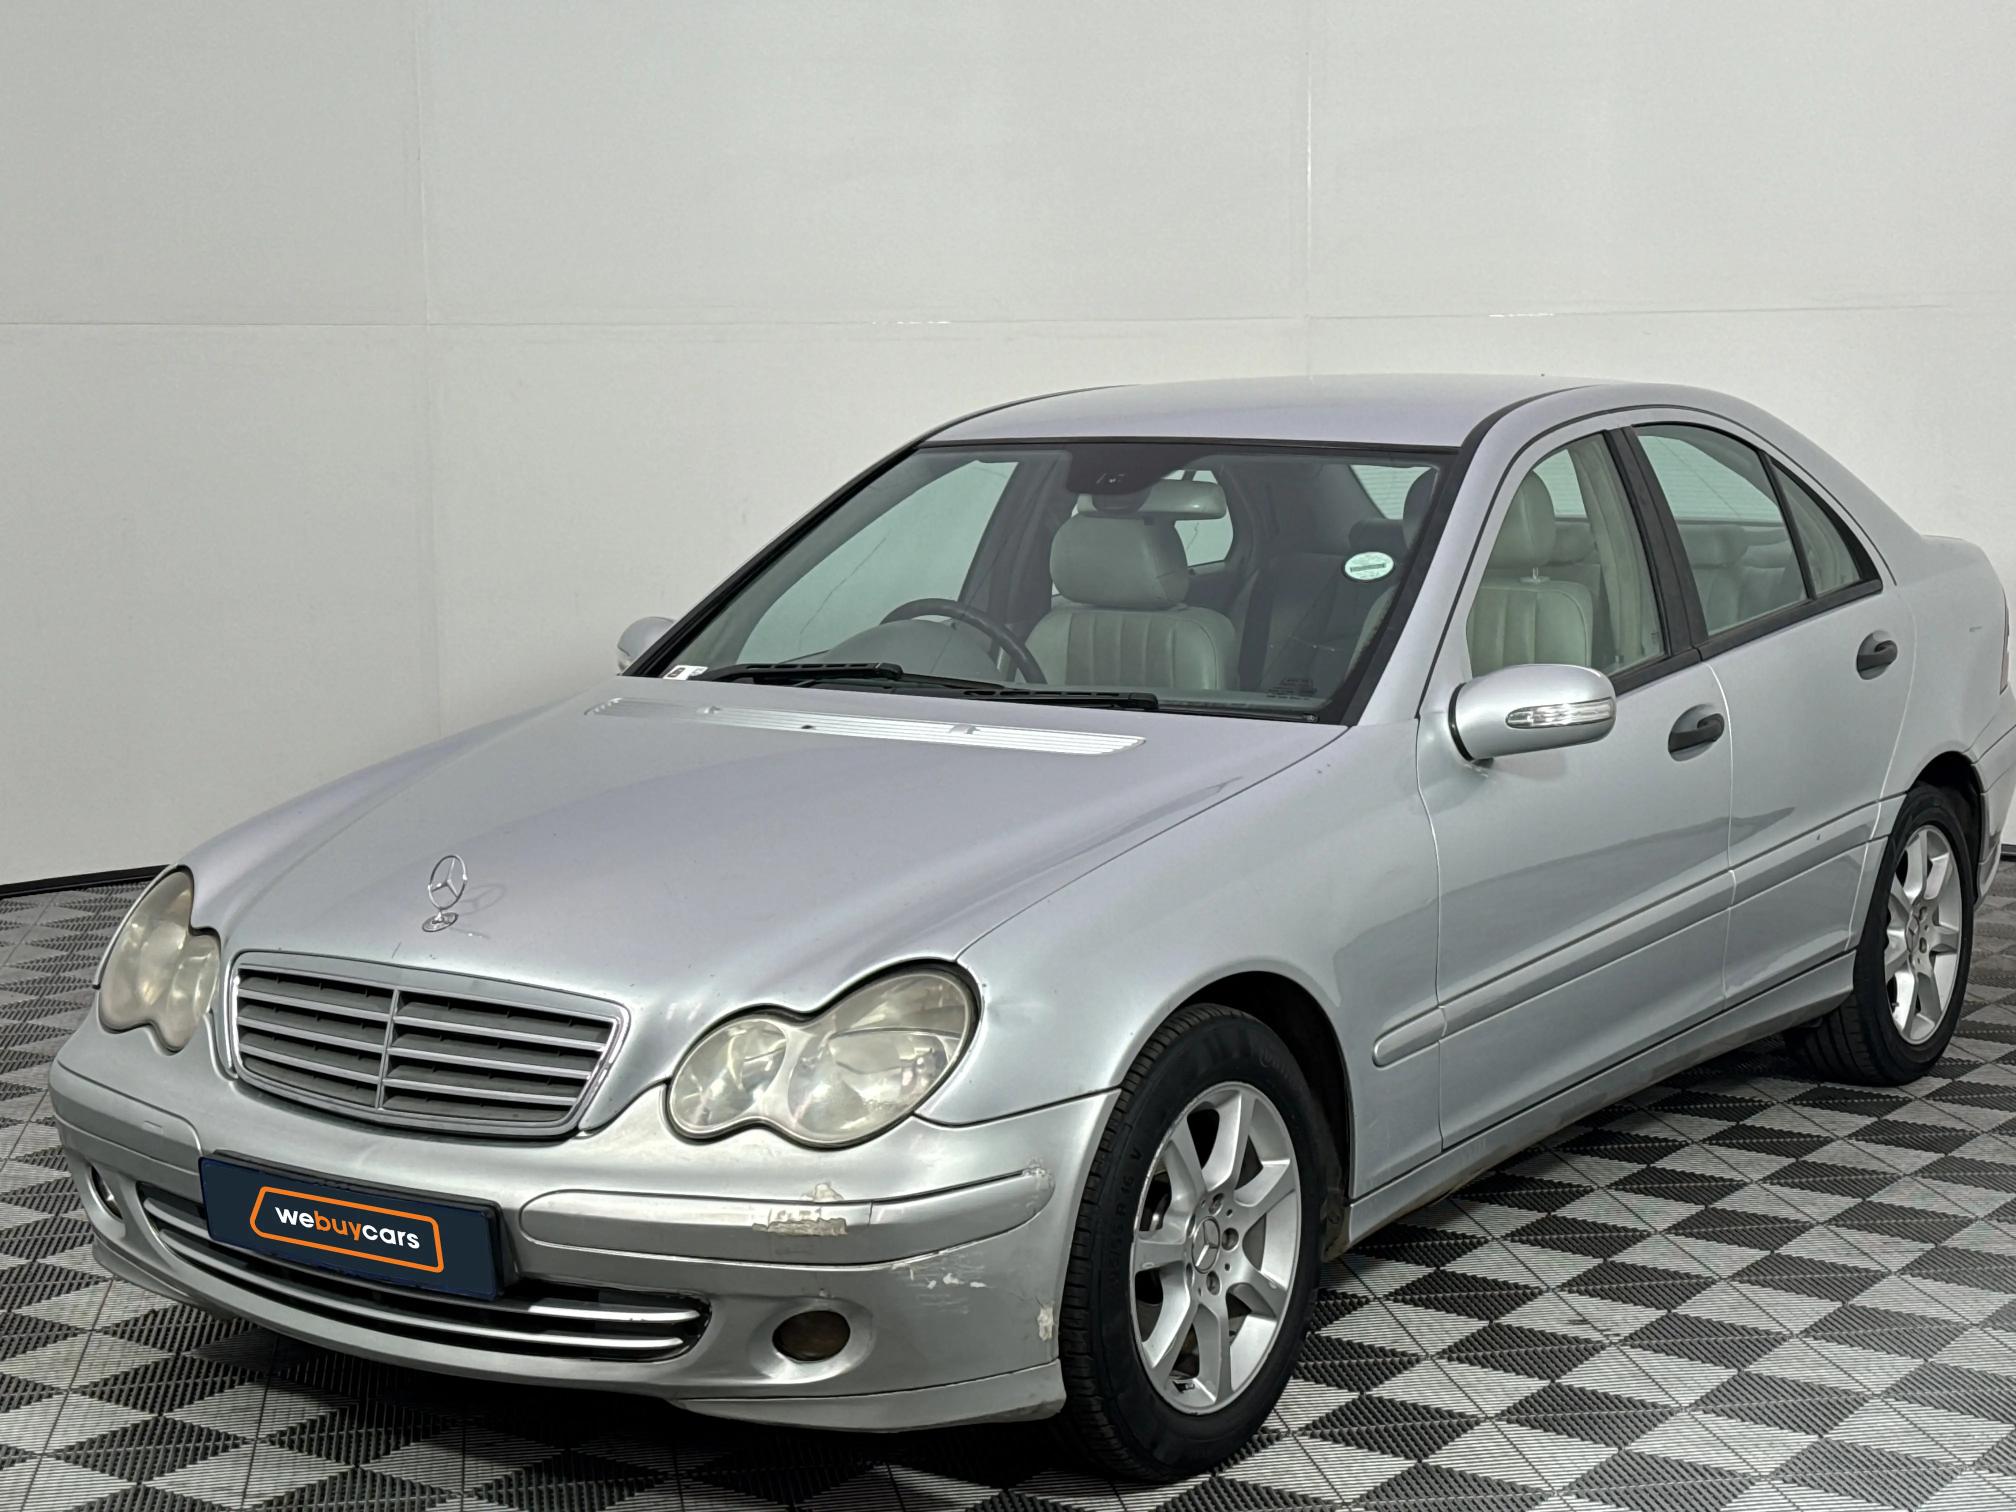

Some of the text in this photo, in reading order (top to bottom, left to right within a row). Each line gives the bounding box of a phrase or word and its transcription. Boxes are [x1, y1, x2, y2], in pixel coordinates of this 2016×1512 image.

[1120, 1175, 1135, 1195] 16
[1116, 1204, 1127, 1217] R
[275, 1206, 420, 1249] webuycars
